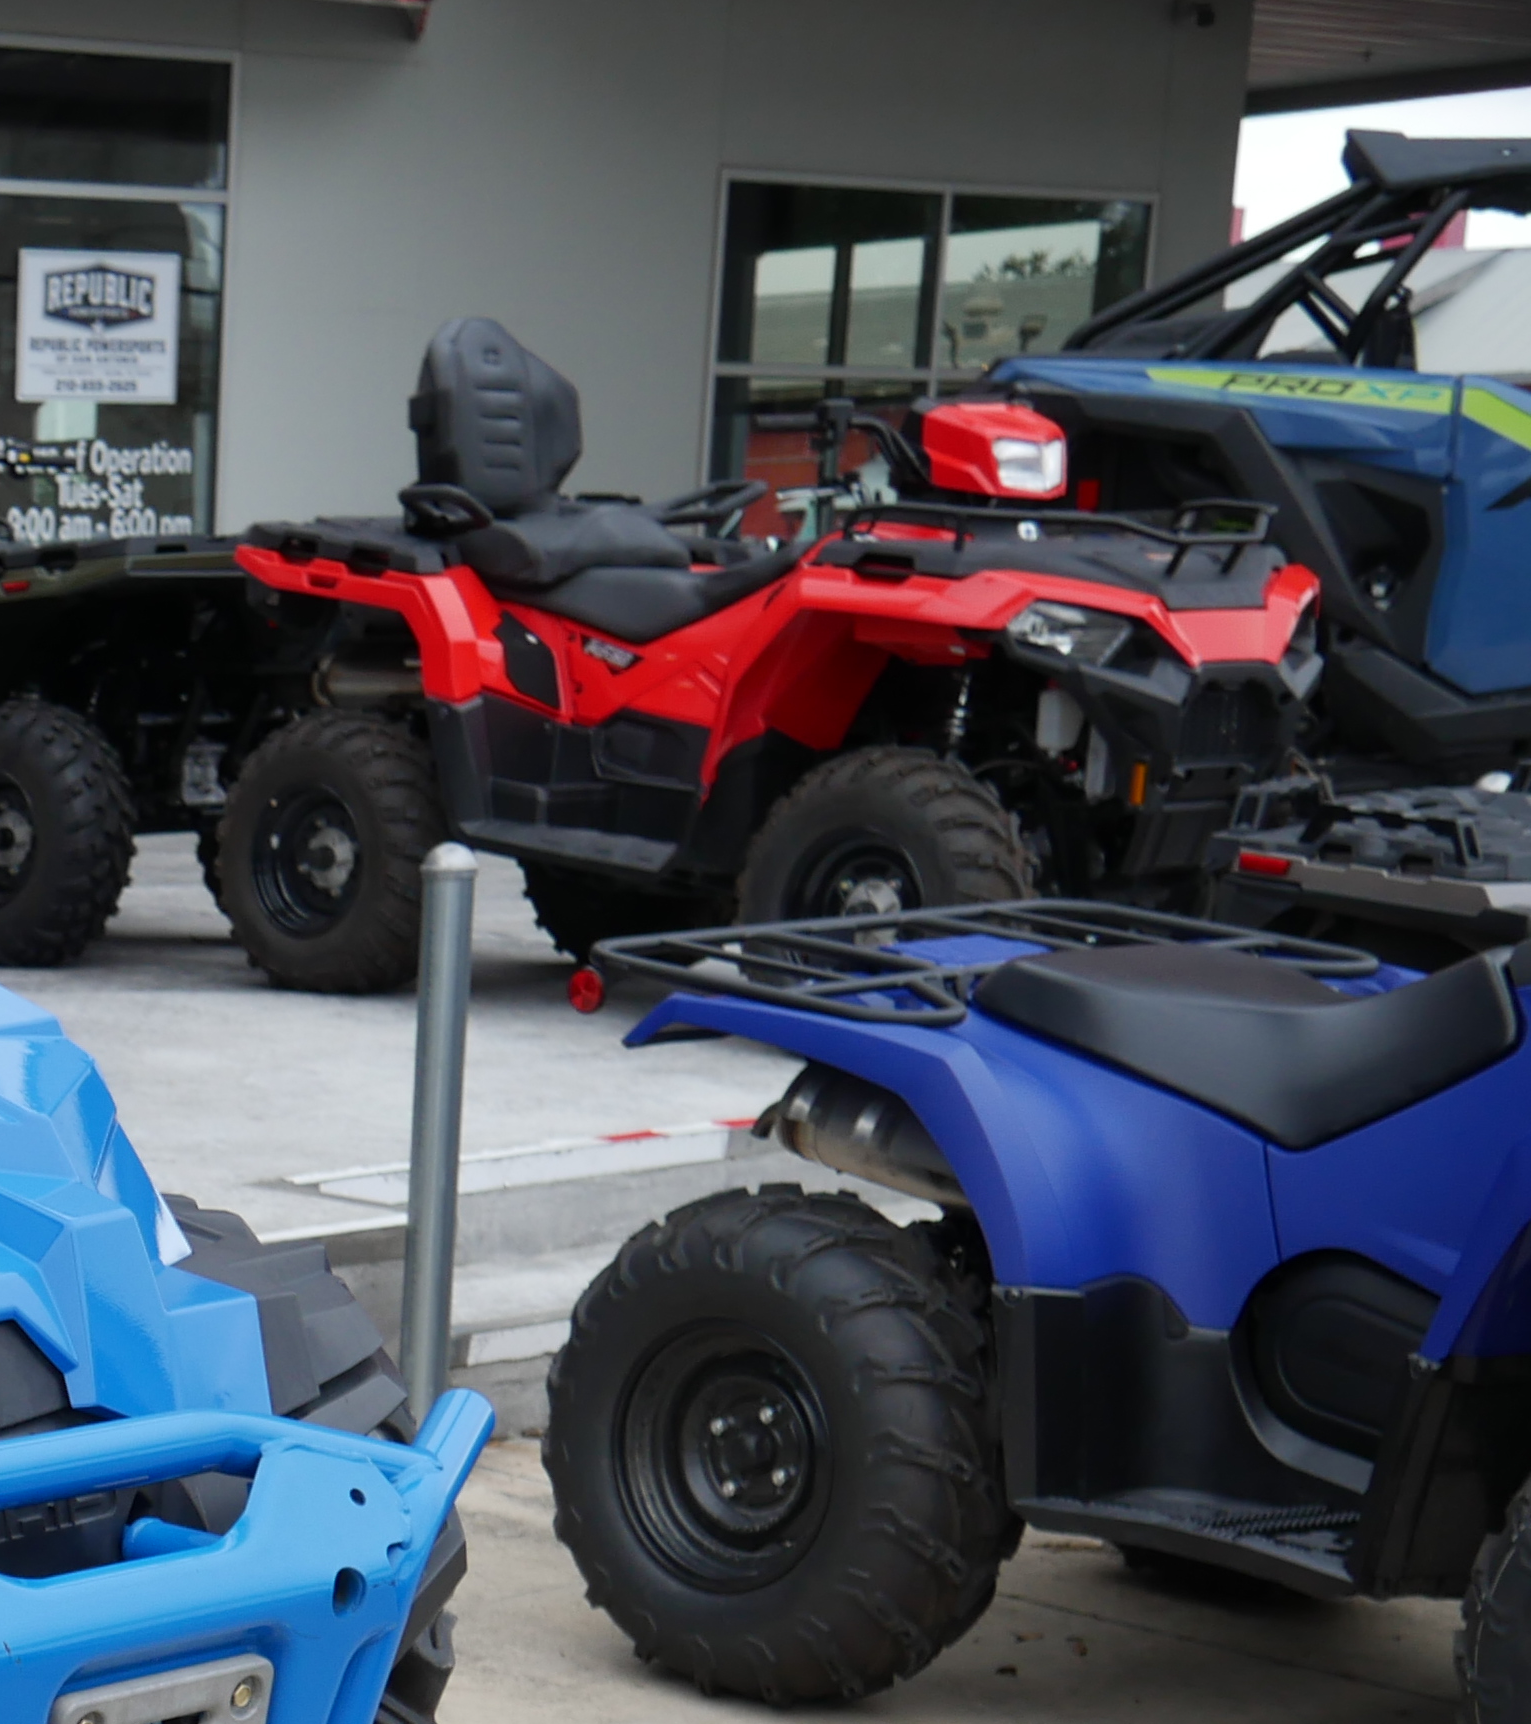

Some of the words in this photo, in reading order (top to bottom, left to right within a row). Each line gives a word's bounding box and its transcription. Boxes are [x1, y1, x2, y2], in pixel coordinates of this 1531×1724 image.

[46, 271, 154, 317] REPUBLIC
[30, 338, 81, 352] REPUBLIC
[86, 340, 165, 354] POWERSPORTS
[1221, 372, 1353, 397] PRO
[90, 439, 193, 476] Operation
[59, 514, 93, 541] am
[109, 505, 158, 540] 6:00
